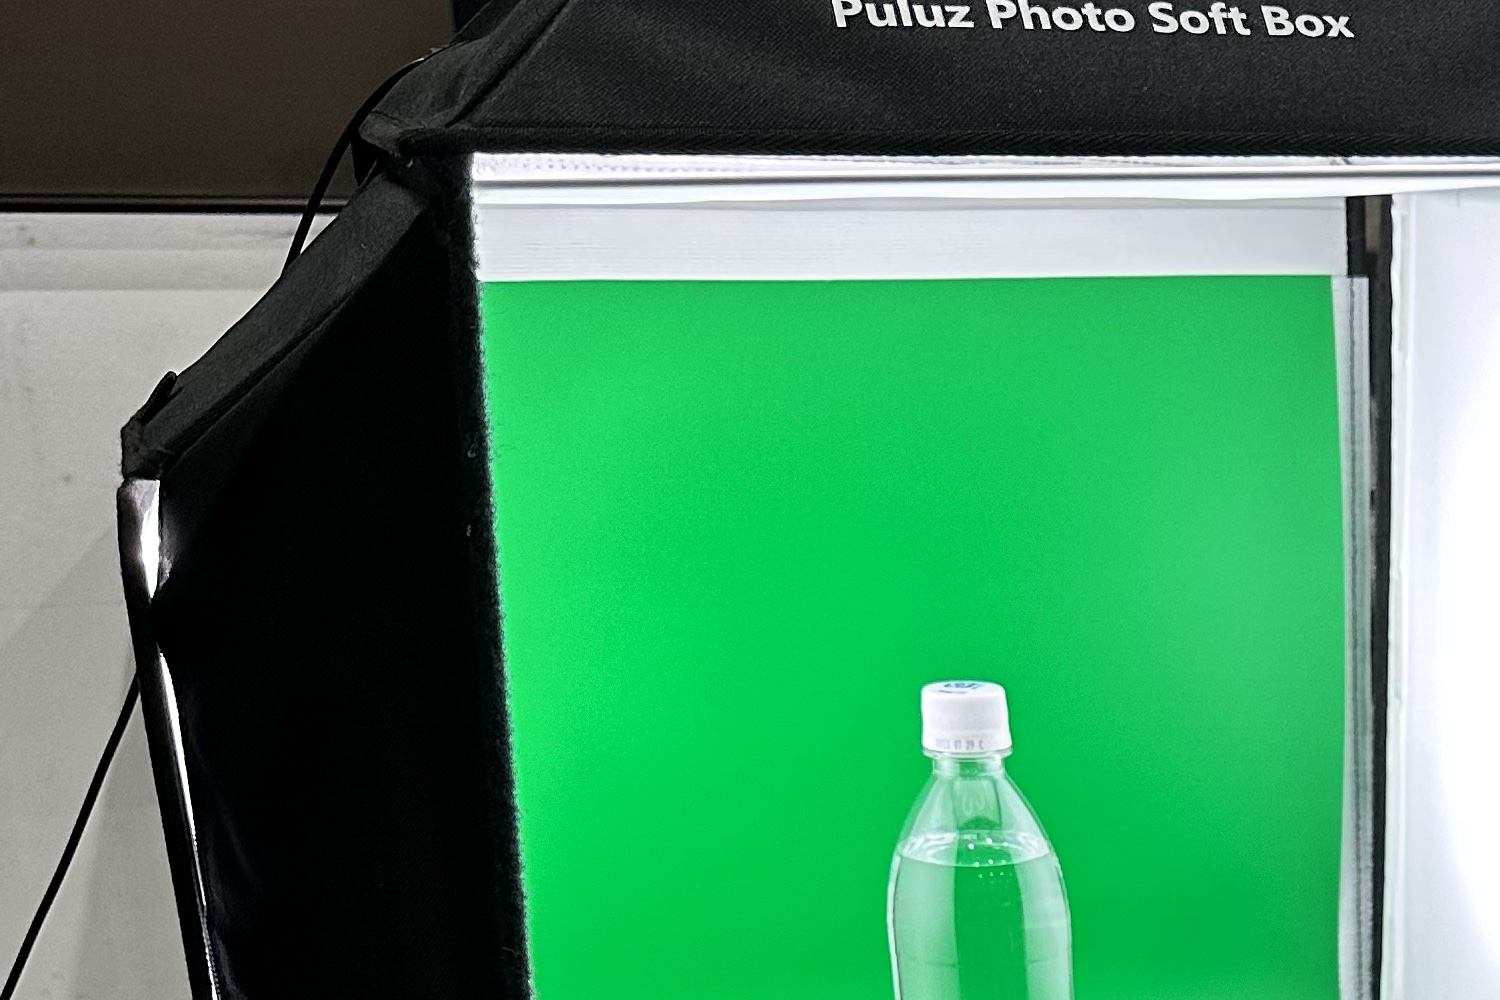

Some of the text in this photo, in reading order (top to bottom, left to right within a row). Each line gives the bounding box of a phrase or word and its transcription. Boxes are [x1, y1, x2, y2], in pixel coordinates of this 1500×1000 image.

[832, 0, 1355, 38] Puluz Photo Soft Box
